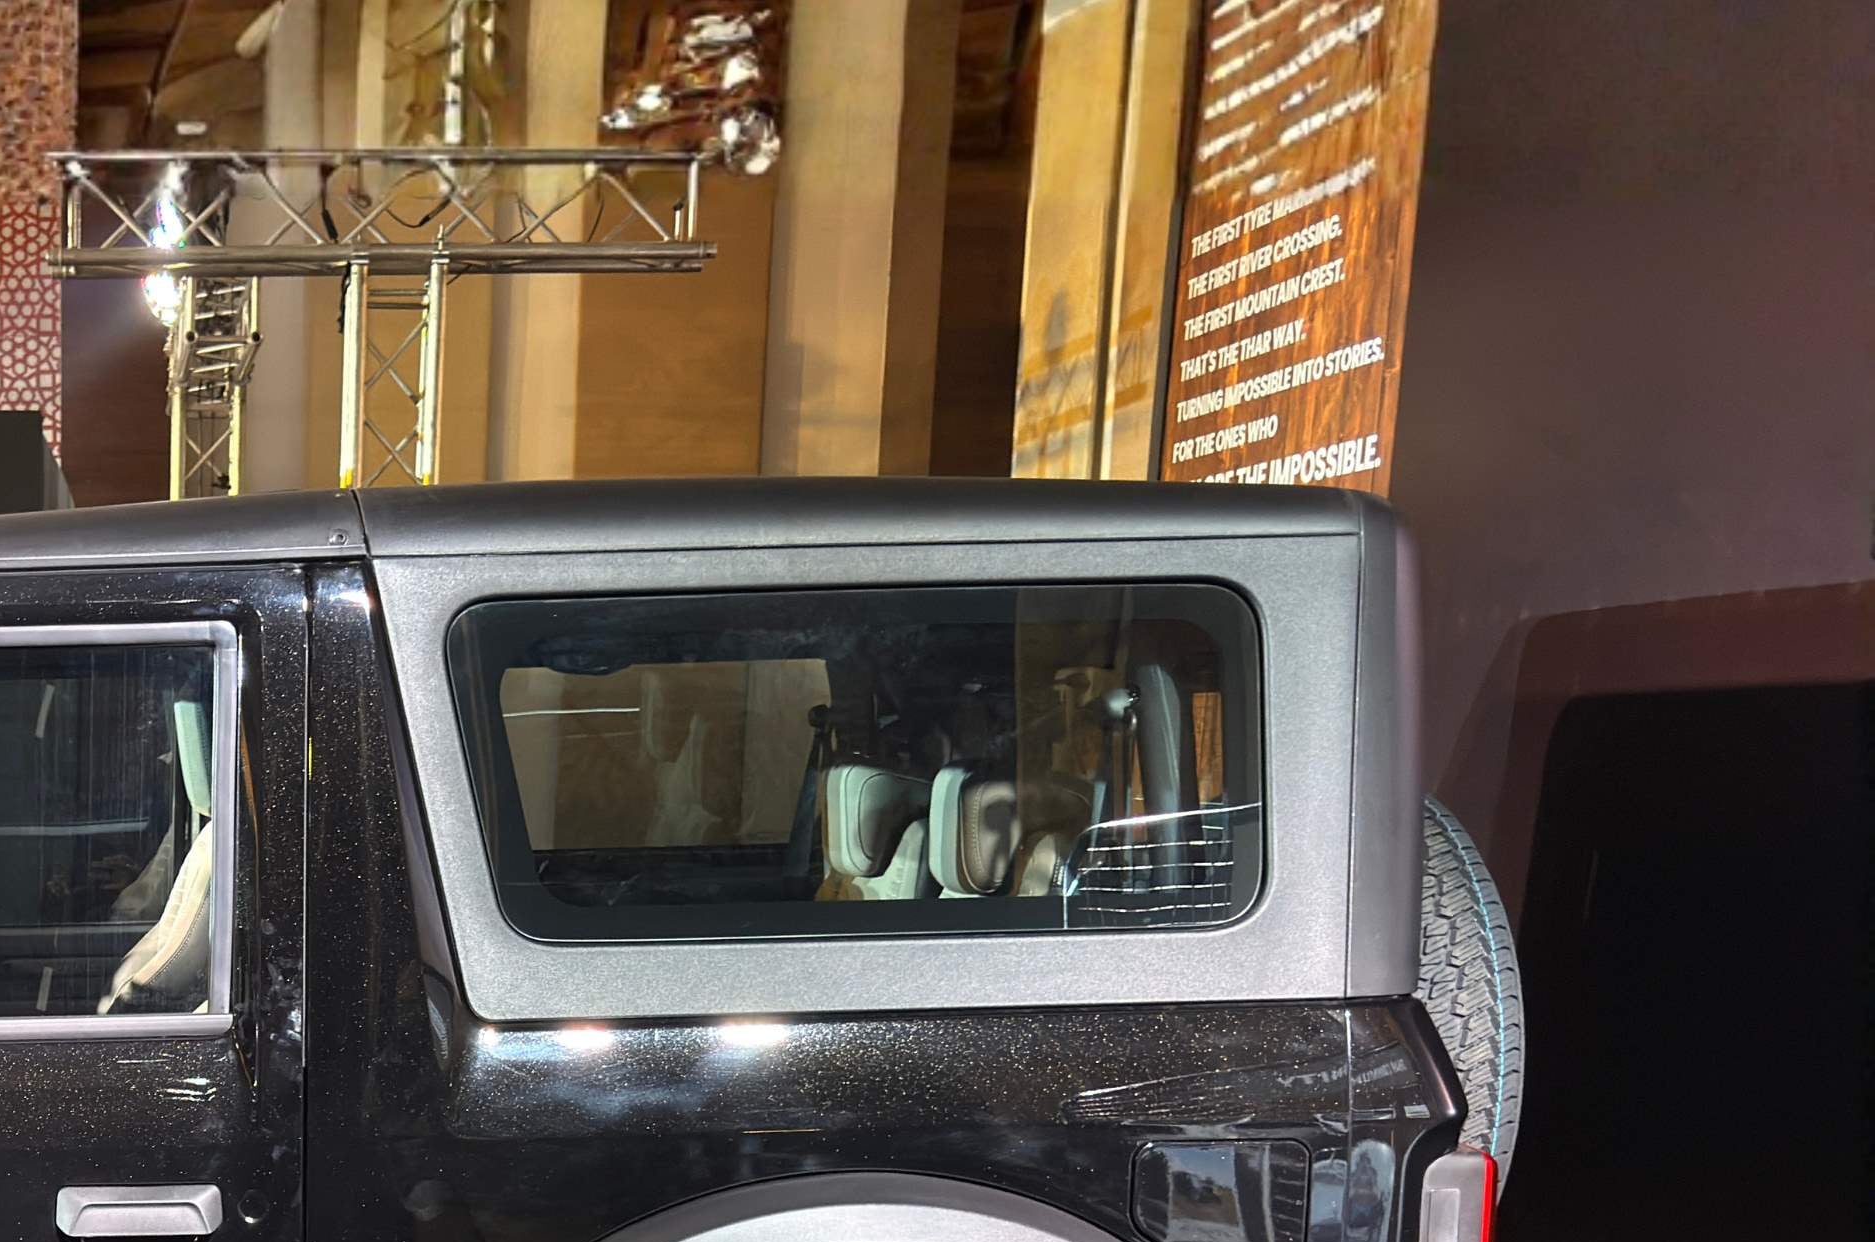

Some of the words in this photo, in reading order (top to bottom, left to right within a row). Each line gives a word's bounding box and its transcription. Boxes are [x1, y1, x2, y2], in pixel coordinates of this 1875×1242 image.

[1188, 270, 1209, 299] THE
[1208, 258, 1239, 291] FIRST
[1238, 245, 1272, 277] RIVER
[1273, 214, 1343, 263] CROSSING.
[1191, 230, 1212, 258] THE
[1212, 215, 1243, 248] FIRST
[1243, 201, 1273, 234] TYRE
[1184, 314, 1205, 341] THE
[1204, 302, 1235, 333] FIRST
[1234, 275, 1301, 322] MOUNTAIN
[1301, 257, 1346, 295] CREST.
[1177, 389, 1223, 423] TURNING
[1223, 367, 1292, 409] IMPOSSIBLE
[1292, 355, 1325, 387] INTO
[1325, 336, 1385, 377] STORIES.
[1180, 349, 1217, 382] THAT'S
[1218, 342, 1239, 369] THE
[1239, 330, 1272, 361] THAR
[1273, 318, 1307, 350] WAY.
[1172, 440, 1194, 464] FOR
[1194, 432, 1216, 458] THE
[1215, 423, 1246, 452] ONES
[1246, 414, 1278, 443] WHO
[1268, 434, 1382, 485] IMPOSSIBLE.
